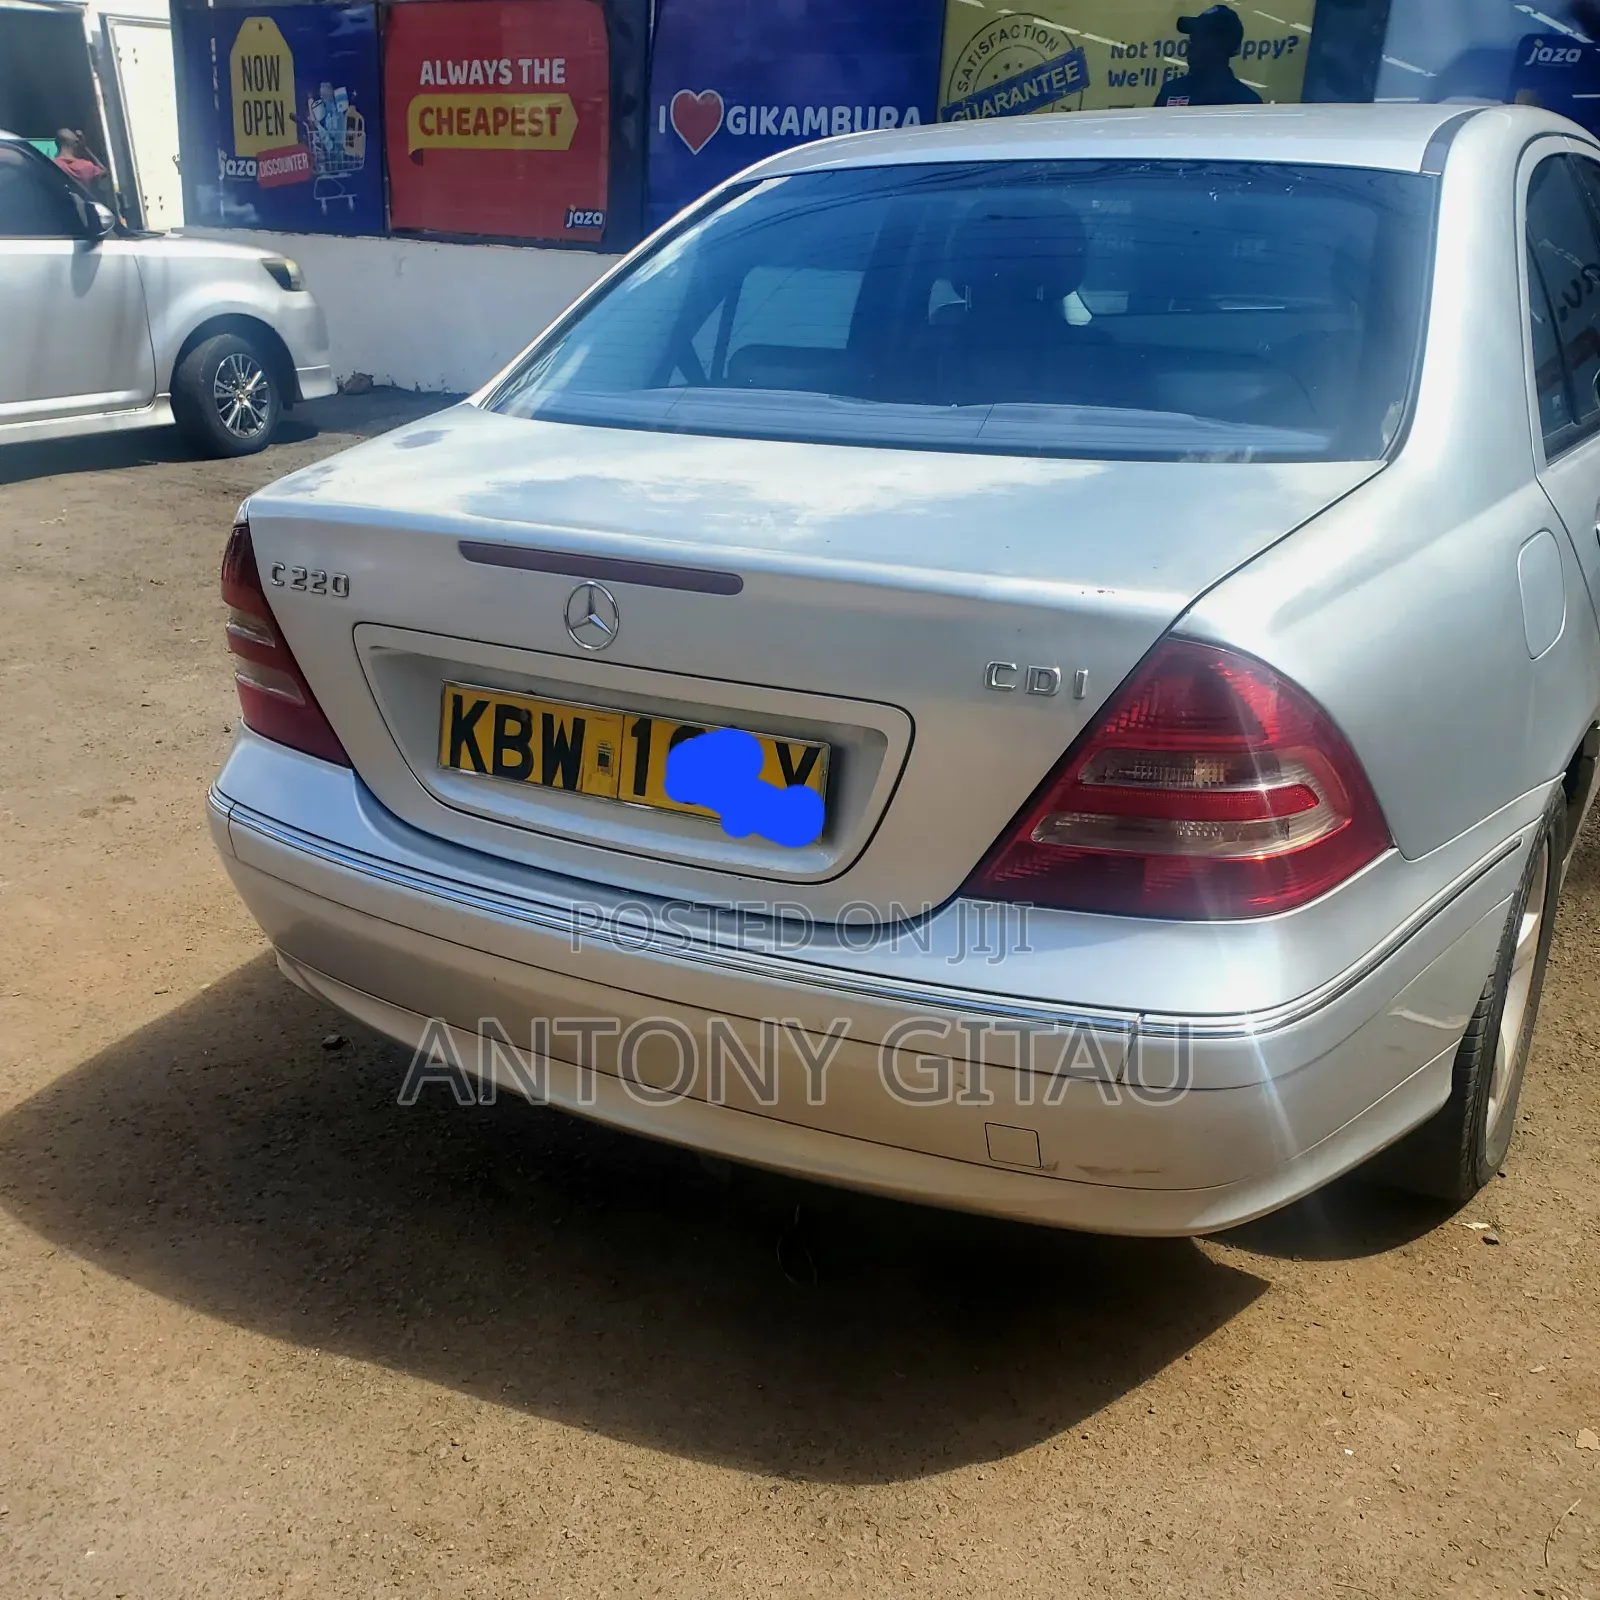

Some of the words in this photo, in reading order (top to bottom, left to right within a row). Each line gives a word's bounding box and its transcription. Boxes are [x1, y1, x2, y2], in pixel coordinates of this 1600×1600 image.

[957, 25, 1059, 92] SATISFACTION
[1110, 40, 1148, 59] Not
[1524, 39, 1582, 66] jaza
[241, 55, 280, 92] NOW
[419, 59, 512, 86] ALWAYS
[518, 58, 566, 84] THE
[1108, 67, 1157, 88] We'll
[242, 100, 285, 136] OPEN
[418, 106, 562, 137] CHEAPEST
[658, 105, 666, 133] I
[726, 105, 921, 136] GIKAMBURA
[218, 149, 257, 180] jaza
[259, 153, 308, 178] DISCOUNTER
[566, 205, 603, 228] jaza
[271, 561, 350, 598] C220
[984, 661, 1089, 700] CDI
[449, 694, 586, 792] KBW
